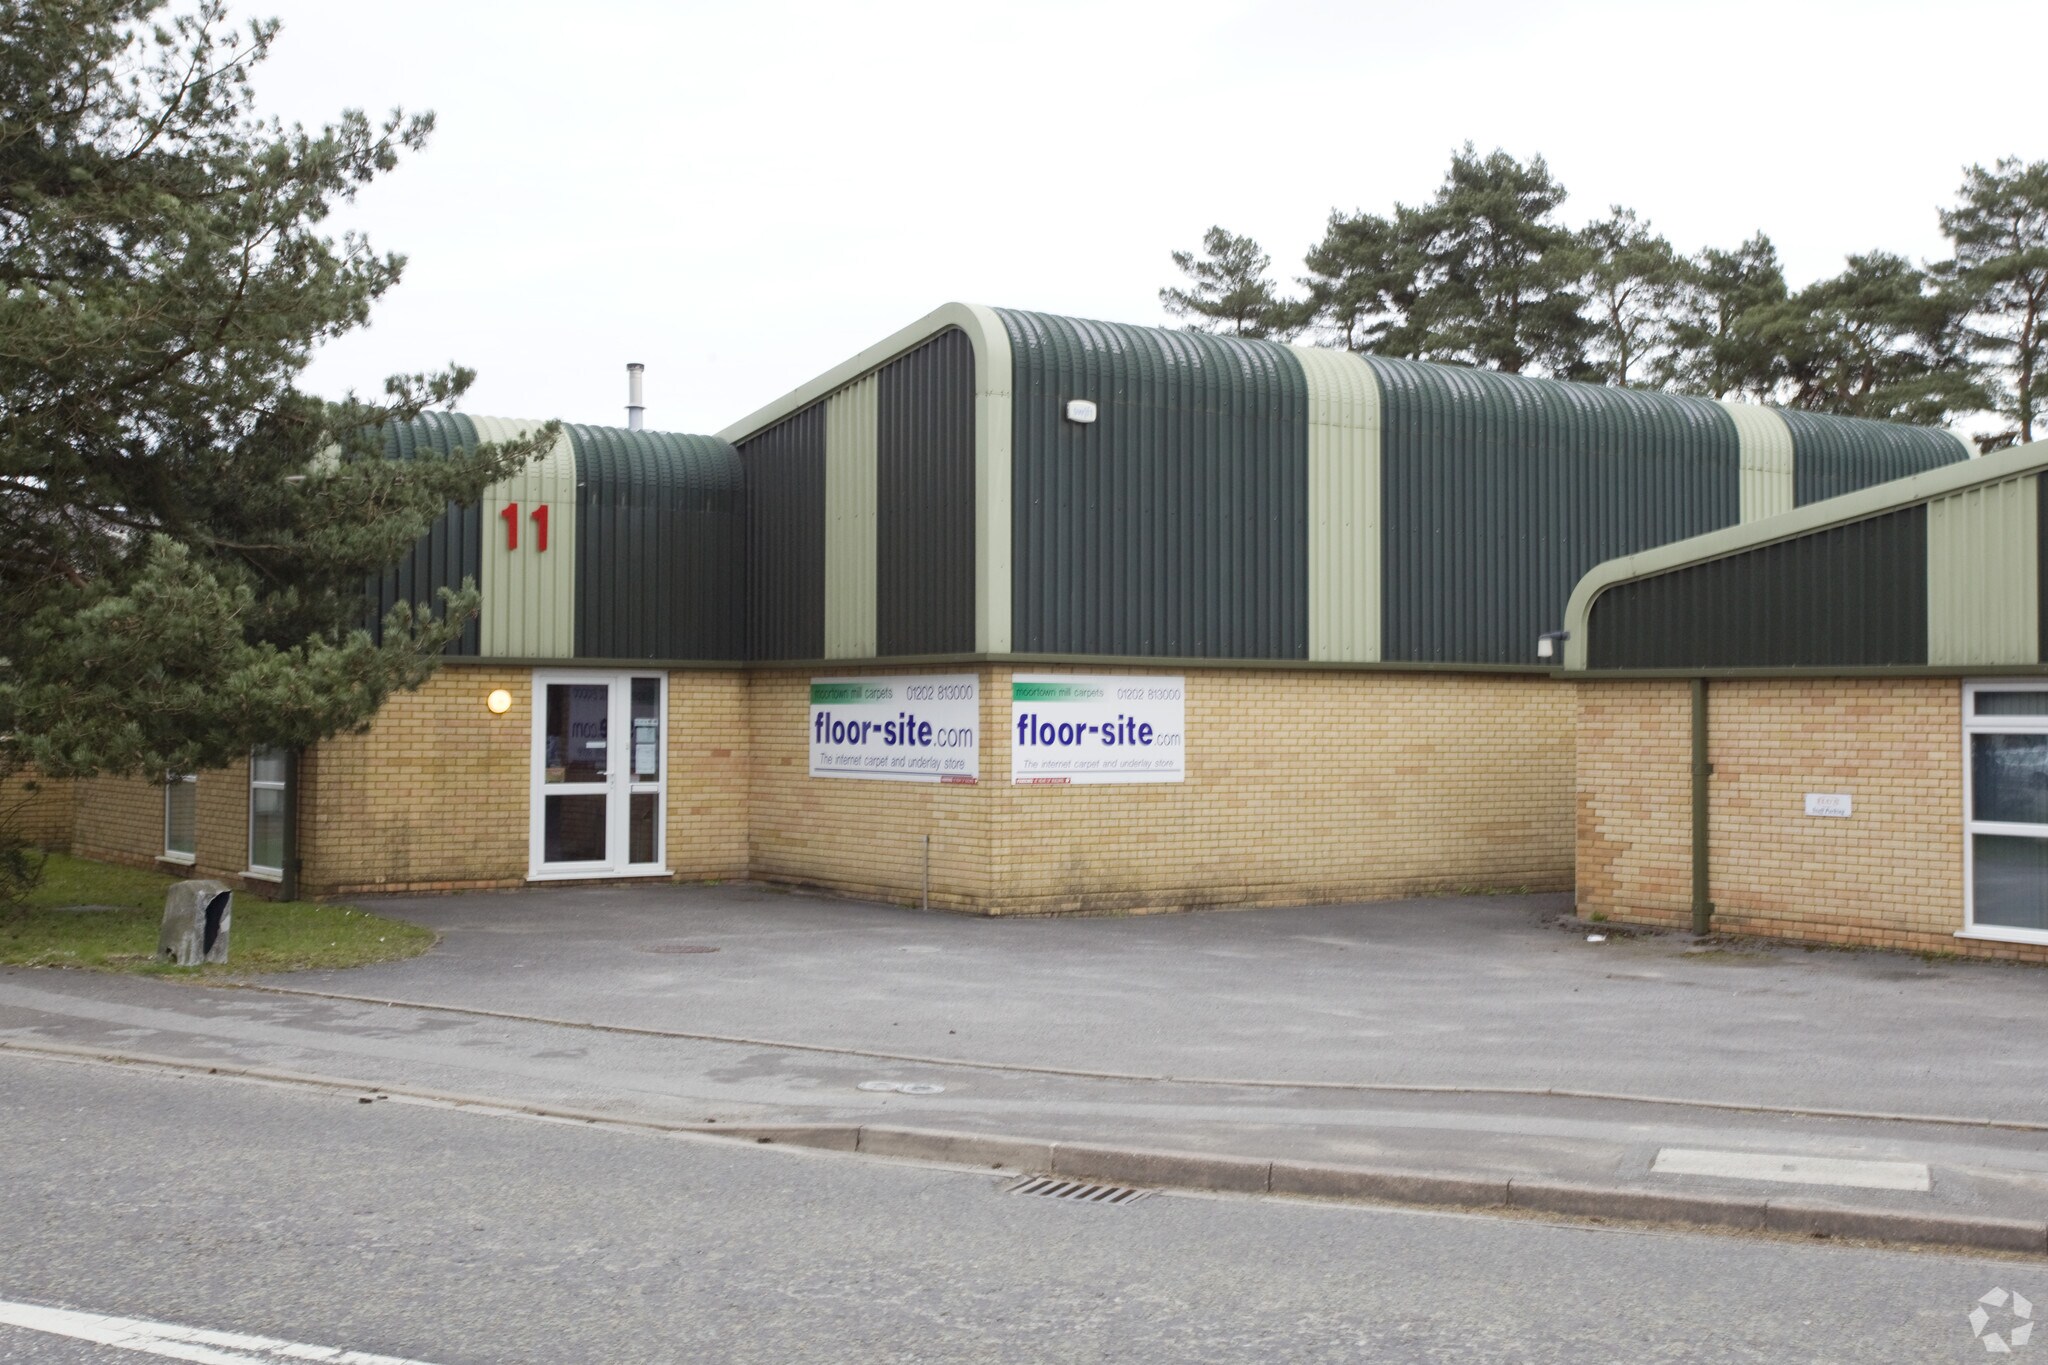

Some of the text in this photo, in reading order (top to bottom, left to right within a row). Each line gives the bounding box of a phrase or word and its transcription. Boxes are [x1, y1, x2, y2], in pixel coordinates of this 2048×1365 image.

[501, 503, 548, 552] 11
[864, 686, 893, 701] carpets
[906, 684, 973, 700] 01202 813000
[1016, 687, 1104, 698] moortown mill carpets
[1117, 688, 1181, 701] 01202 813000
[815, 711, 973, 748] floor-site.com
[1017, 713, 1181, 747] floor-site.com
[820, 752, 965, 771] The internet carpet and underlay store
[1023, 758, 1174, 770] The internet carpet and underlay store
